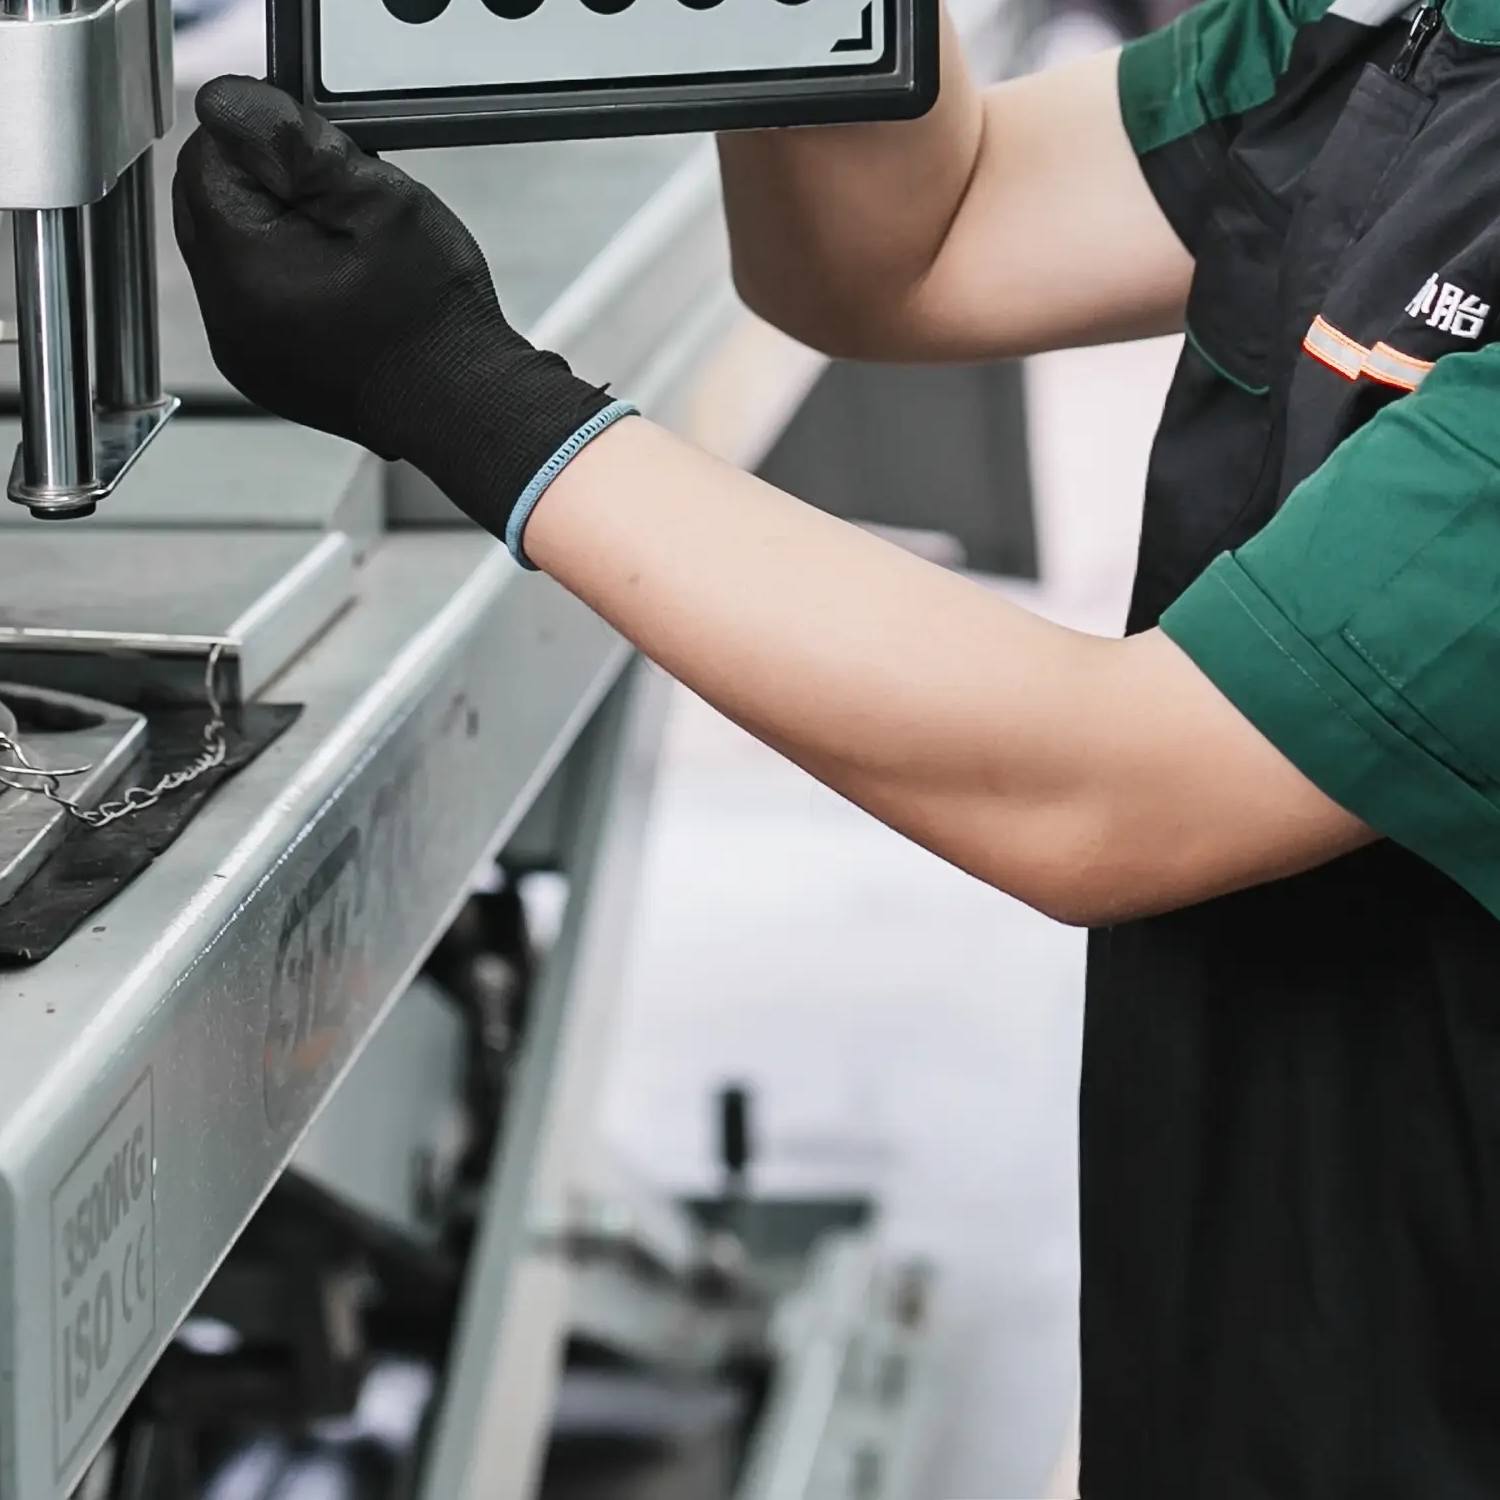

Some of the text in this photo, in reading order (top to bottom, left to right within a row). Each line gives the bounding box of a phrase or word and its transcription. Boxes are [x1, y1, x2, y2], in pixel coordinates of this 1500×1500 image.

[61, 1124, 147, 1298] 3500KG
[62, 1222, 148, 1424] ISO CE
